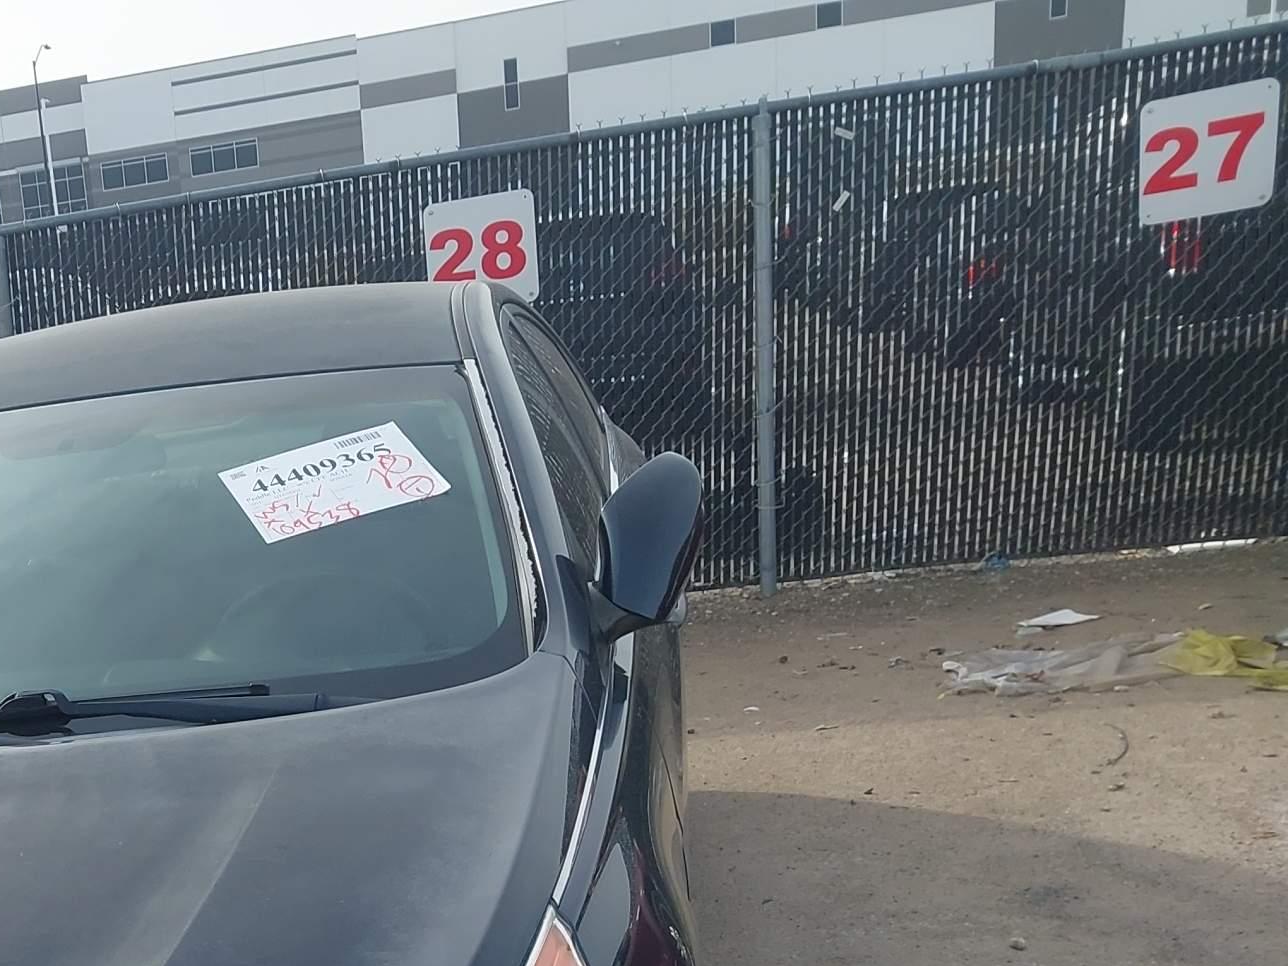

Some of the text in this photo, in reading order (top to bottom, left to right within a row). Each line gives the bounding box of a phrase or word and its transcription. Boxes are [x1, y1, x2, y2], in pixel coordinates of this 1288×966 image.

[1143, 111, 1265, 195] 27
[429, 220, 527, 282] 28
[252, 442, 392, 493] 44409365
